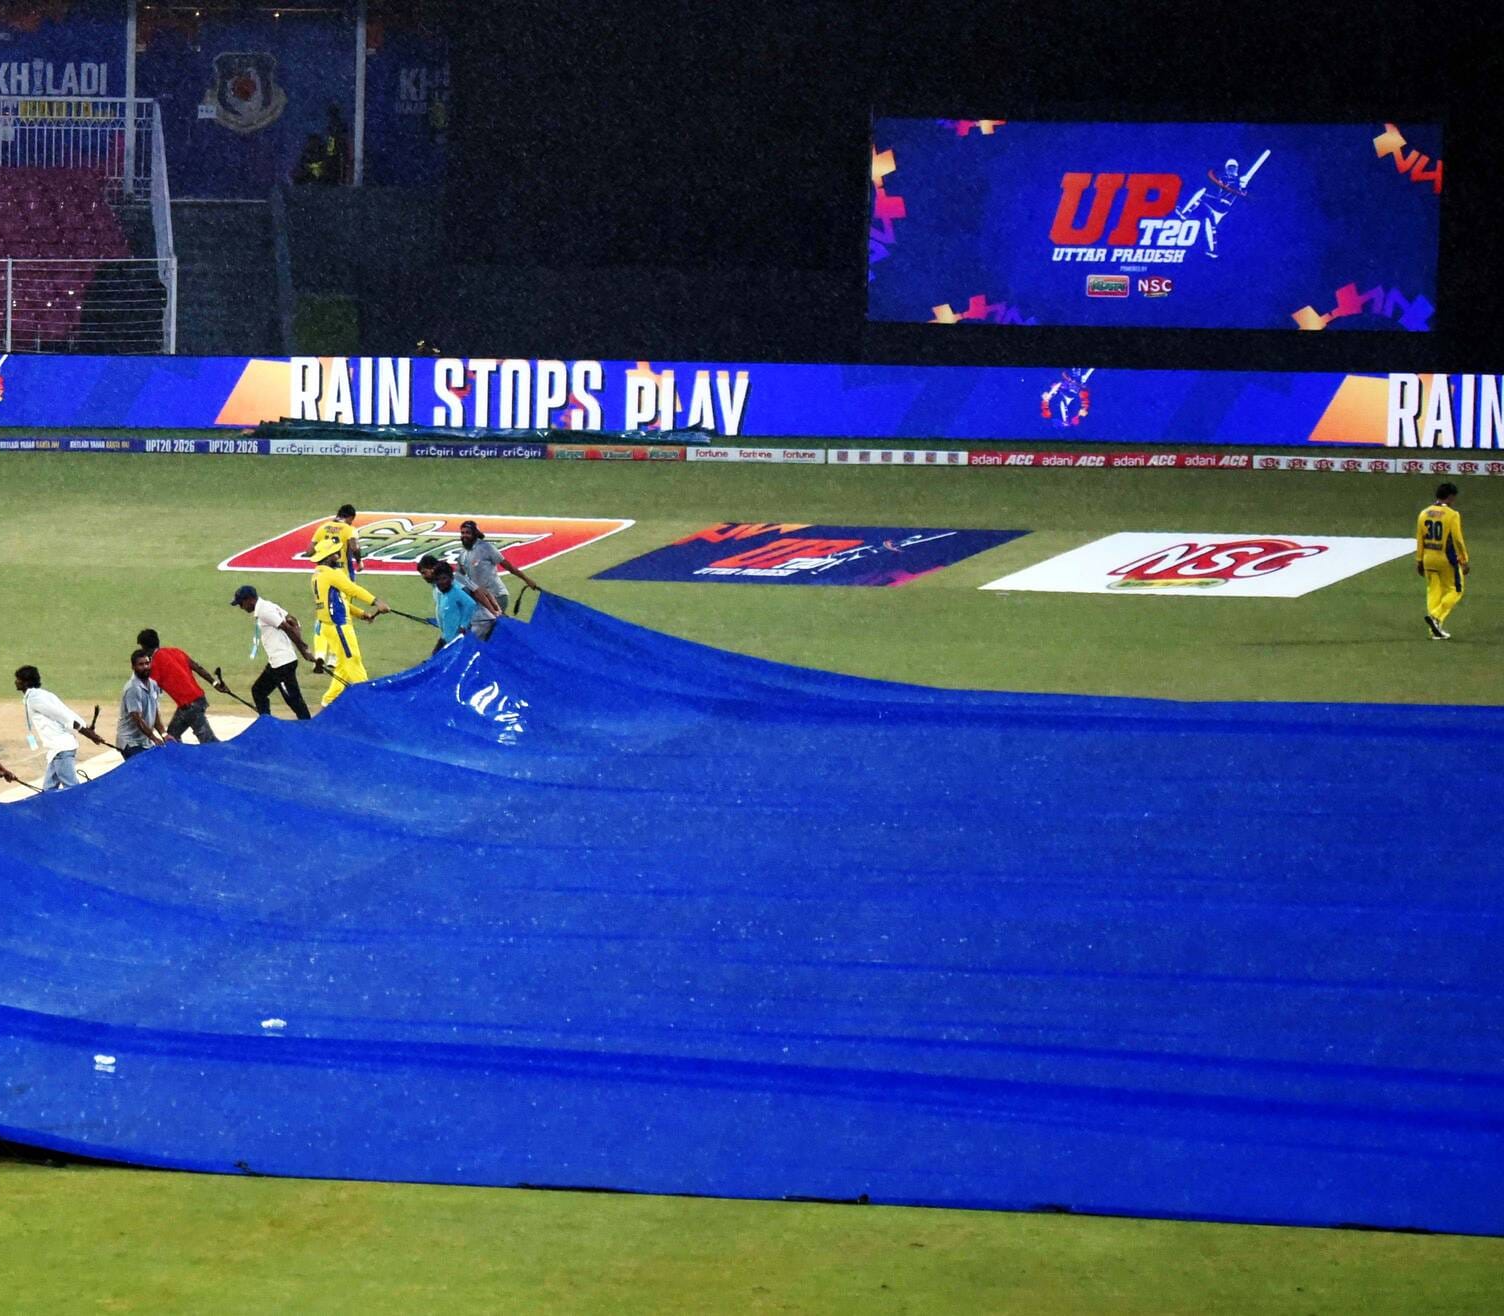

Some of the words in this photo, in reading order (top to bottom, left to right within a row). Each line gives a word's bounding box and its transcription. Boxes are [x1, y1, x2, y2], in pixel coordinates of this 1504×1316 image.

[1049, 172, 1183, 245] UP
[1139, 219, 1202, 247] T20
[1052, 248, 1108, 263] UTTAR
[1110, 249, 1186, 264] PRADESH
[1137, 279, 1173, 292] NSC
[290, 356, 410, 425] RAIN
[434, 358, 602, 431] STOPS
[146, 440, 171, 453] UPT20
[173, 440, 195, 453] 2026
[209, 440, 234, 454] UPT20
[237, 440, 259, 454] 2026
[695, 449, 728, 458] fortune
[783, 450, 816, 459] fortune
[971, 454, 1002, 465] adani
[1004, 454, 1035, 465] ACC
[1042, 455, 1073, 466] adani
[1075, 455, 1106, 466] ACC
[1113, 455, 1144, 466] adani
[1146, 455, 1177, 466] ACC
[1184, 455, 1216, 466] adani
[1218, 455, 1249, 466] ACC
[1259, 458, 1280, 467] NSC
[1314, 459, 1334, 468] NSC
[1368, 460, 1389, 470] NSC
[1402, 461, 1423, 471] NSC
[1430, 462, 1451, 471] NSC
[1457, 462, 1478, 472] NSC
[1484, 462, 1504, 472] NSC
[1424, 519, 1443, 541] 30
[1107, 543, 1329, 578] NSC
